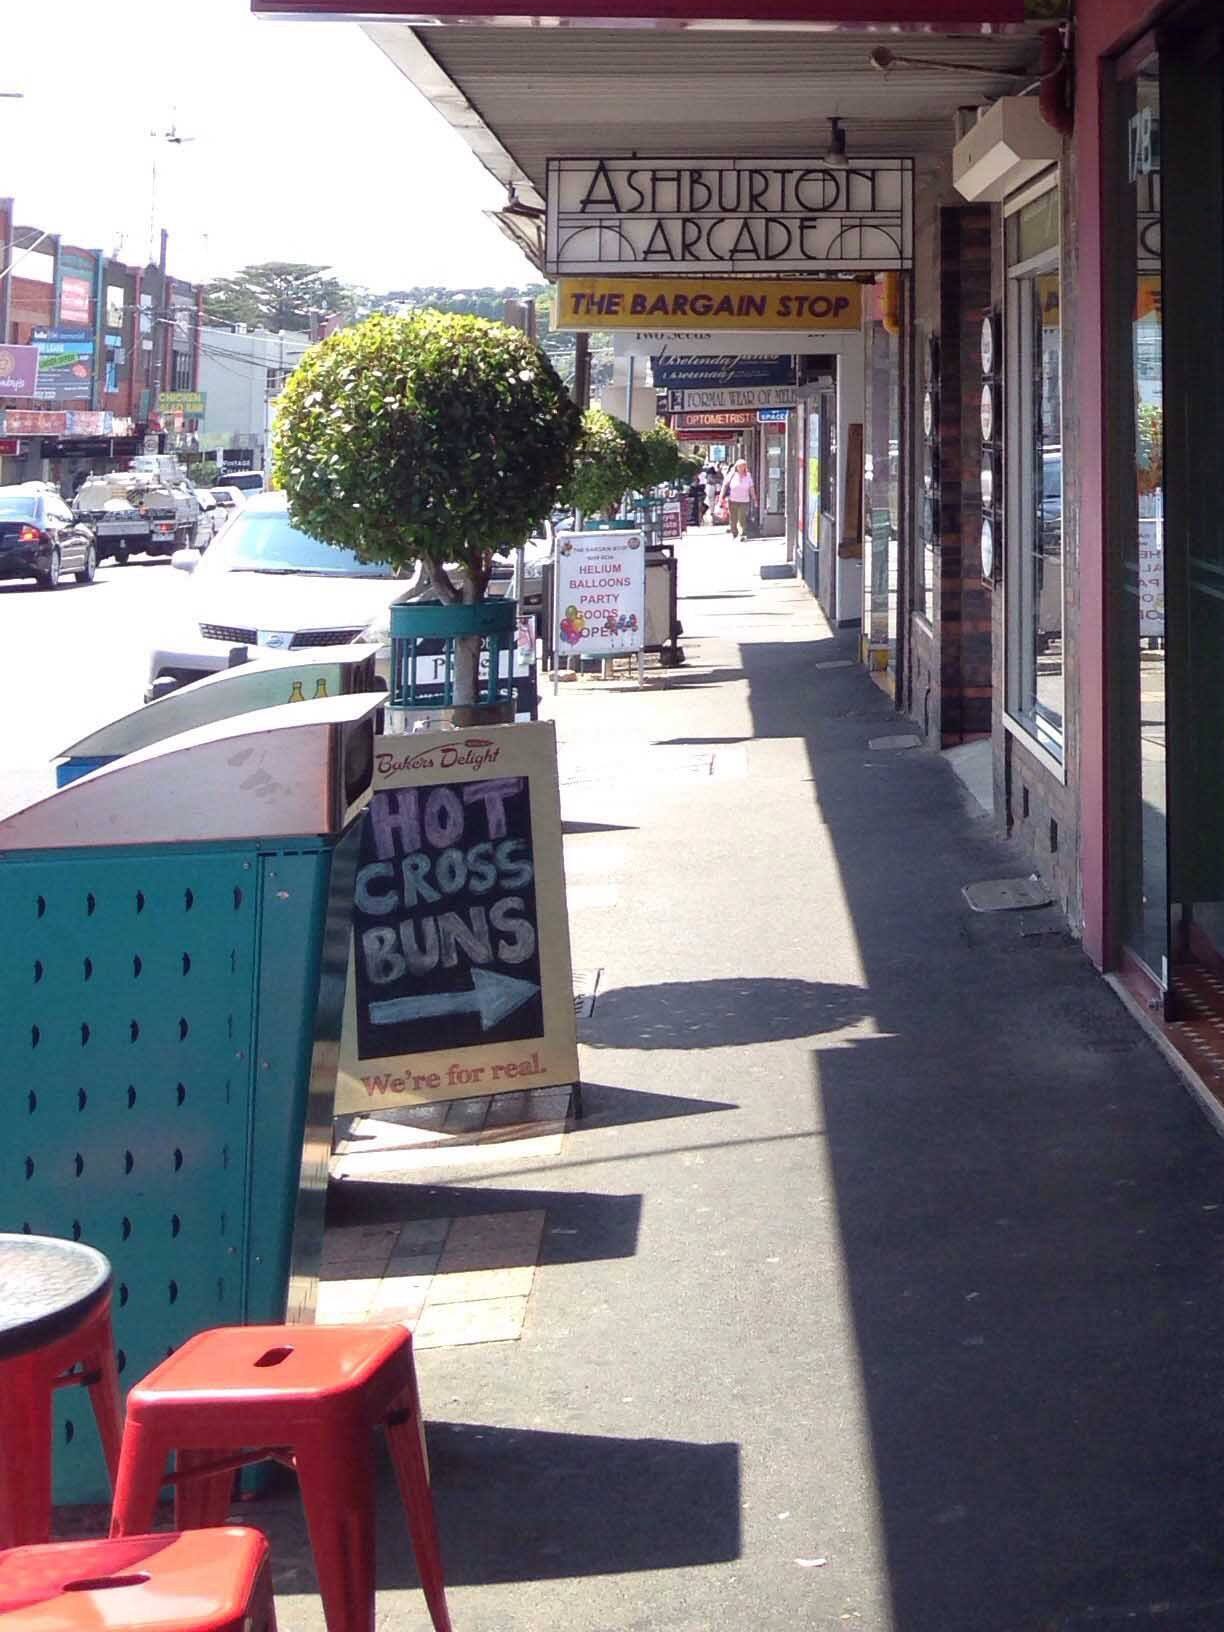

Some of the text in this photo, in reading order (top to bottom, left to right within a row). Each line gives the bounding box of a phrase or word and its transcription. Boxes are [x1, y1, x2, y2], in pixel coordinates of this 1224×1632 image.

[580, 157, 876, 213] ASHBURTON
[642, 218, 817, 261] ARCADE
[570, 292, 850, 318] THE BARGAIN STOP
[569, 577, 631, 589] BALLOONS
[579, 563, 622, 575] HELIUM
[576, 608, 619, 620] GOODS
[580, 594, 620, 605] PARTY
[580, 626, 619, 638] OPEN
[375, 746, 500, 780] Bakers Delight
[368, 778, 524, 861] HOT
[354, 837, 535, 916] CROSS
[361, 895, 536, 985] BUNS
[360, 1051, 547, 1099] We're for real.
